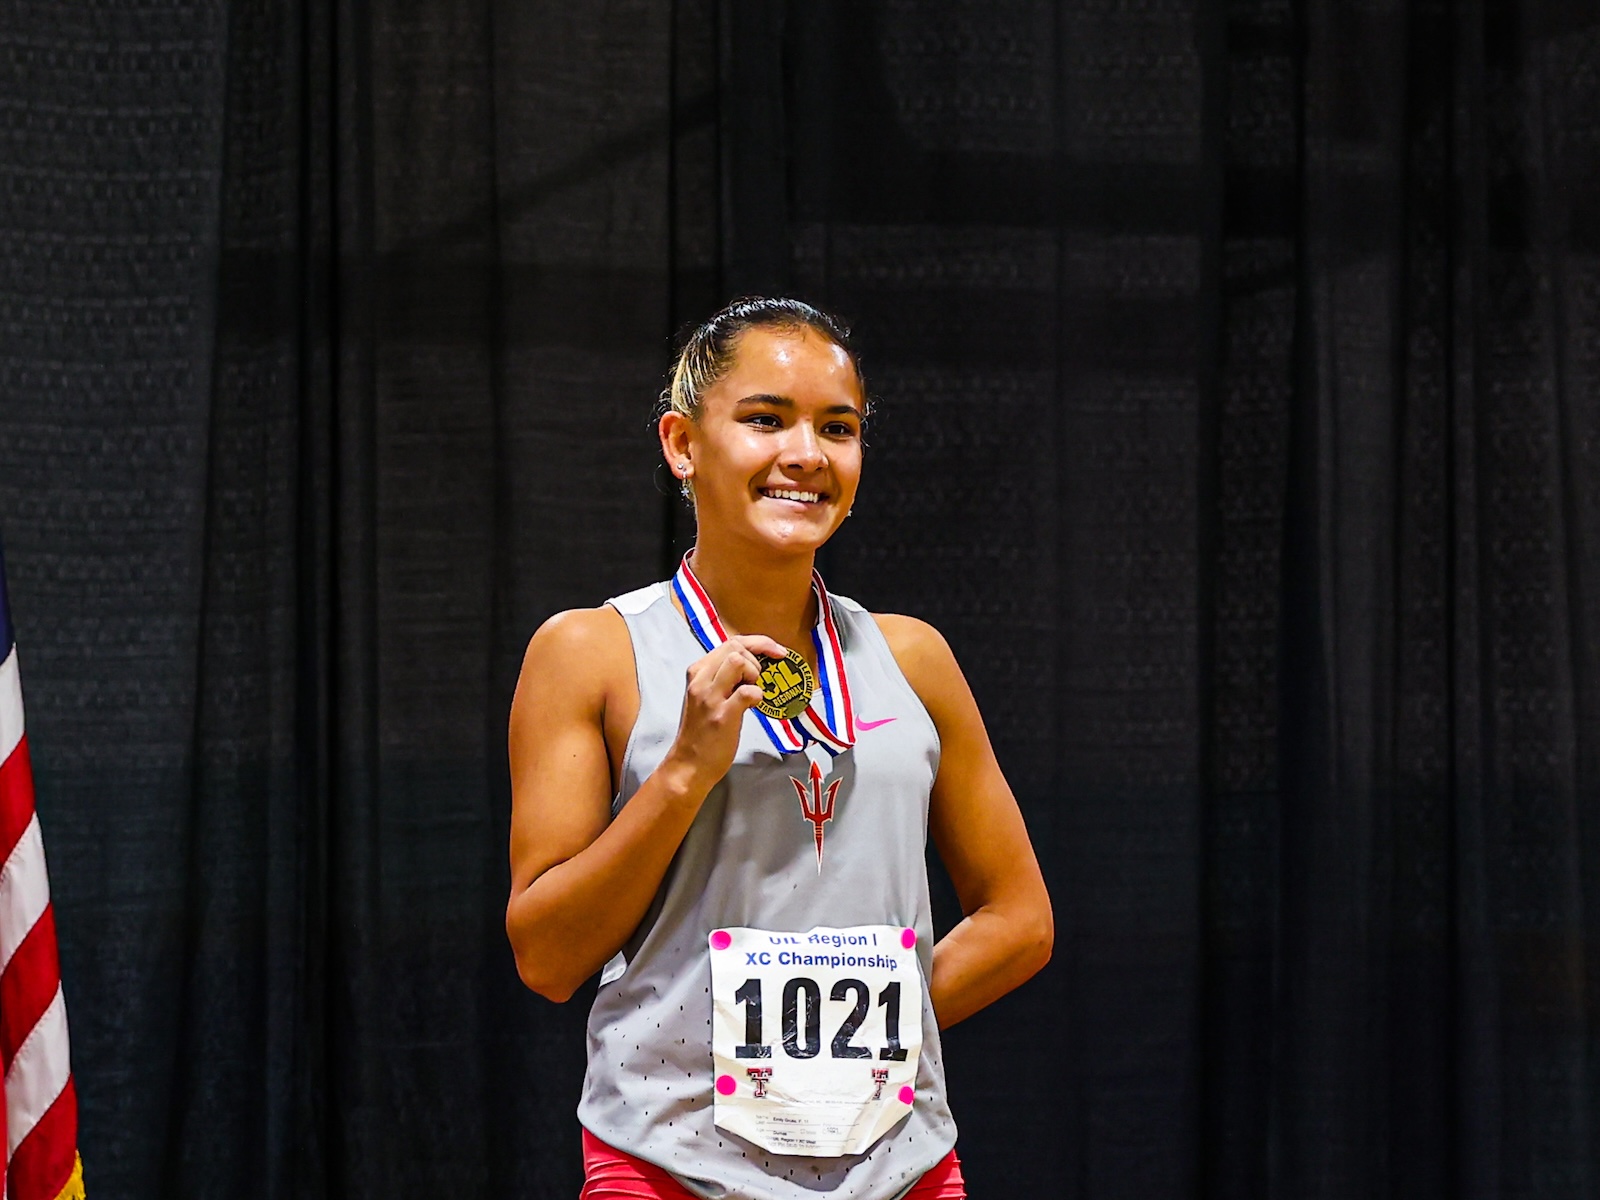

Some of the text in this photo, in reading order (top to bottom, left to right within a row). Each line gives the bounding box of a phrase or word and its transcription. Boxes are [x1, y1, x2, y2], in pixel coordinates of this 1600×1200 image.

[801, 665, 813, 698] LEAGUE
[773, 685, 803, 707] REGIONAL
[808, 933, 867, 947] Region
[745, 951, 898, 971] XC Championship
[735, 977, 909, 1062] 1021
